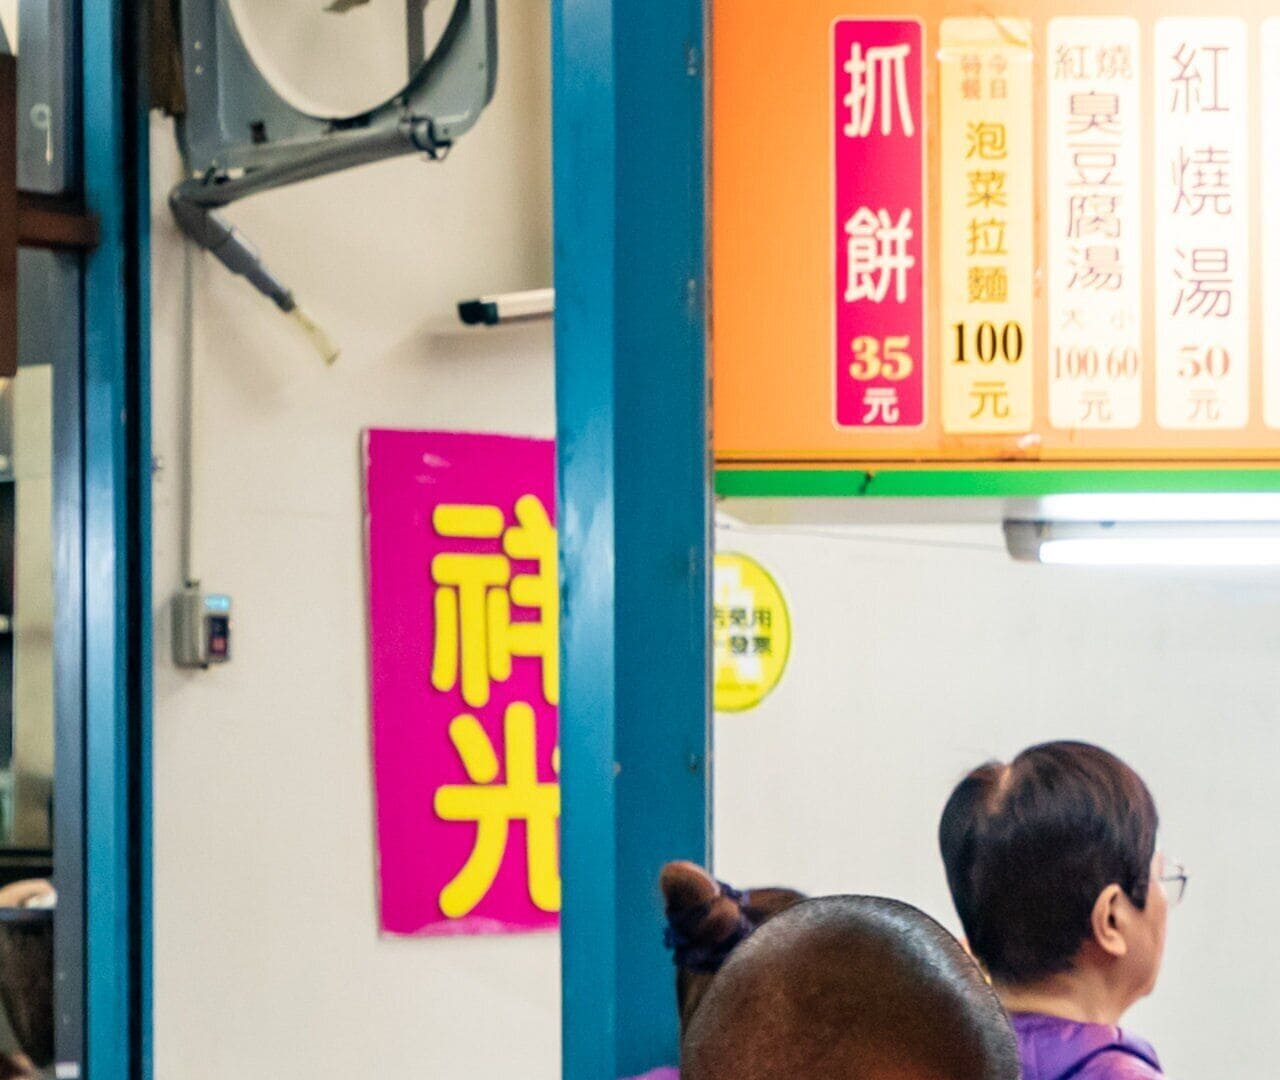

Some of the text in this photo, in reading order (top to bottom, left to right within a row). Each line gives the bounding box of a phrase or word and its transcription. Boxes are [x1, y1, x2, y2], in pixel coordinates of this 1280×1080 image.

[1055, 45, 1133, 80] 紅燒
[843, 42, 914, 304] 抓餅
[1067, 92, 1124, 293] 臭豆腐湯
[1171, 41, 1233, 321] 紅燒湯
[964, 121, 1009, 306] 泡菜拉麵
[849, 335, 913, 381] 35
[952, 320, 1025, 365] 100
[1054, 346, 1139, 380] 100 60
[1177, 345, 1231, 379] 50
[861, 388, 900, 425] 元
[968, 381, 1009, 421] 元
[1079, 387, 1112, 422] 元
[430, 493, 560, 920] 祥光
